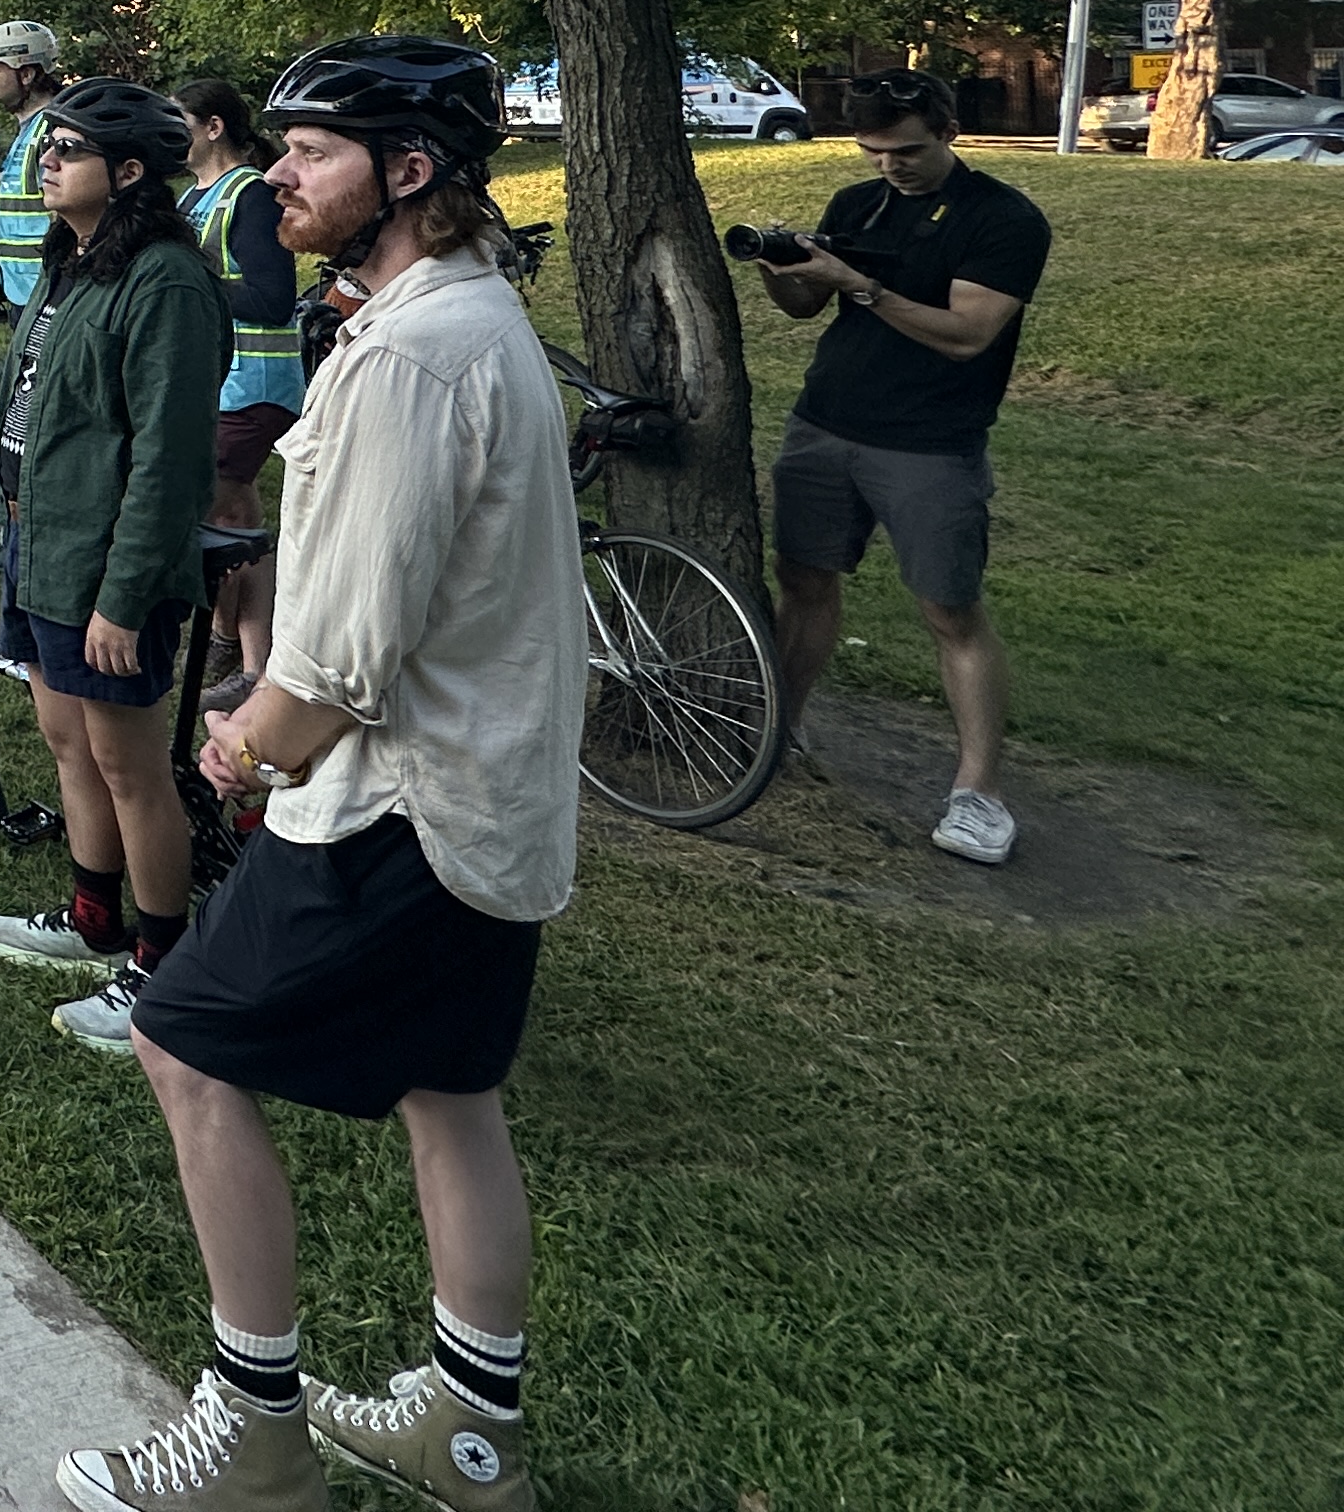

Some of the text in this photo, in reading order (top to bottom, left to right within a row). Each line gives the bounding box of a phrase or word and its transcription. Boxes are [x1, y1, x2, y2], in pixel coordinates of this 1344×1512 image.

[1148, 6, 1175, 18] ONE
[1148, 19, 1175, 31] WAY
[1142, 58, 1173, 68] EXCE
